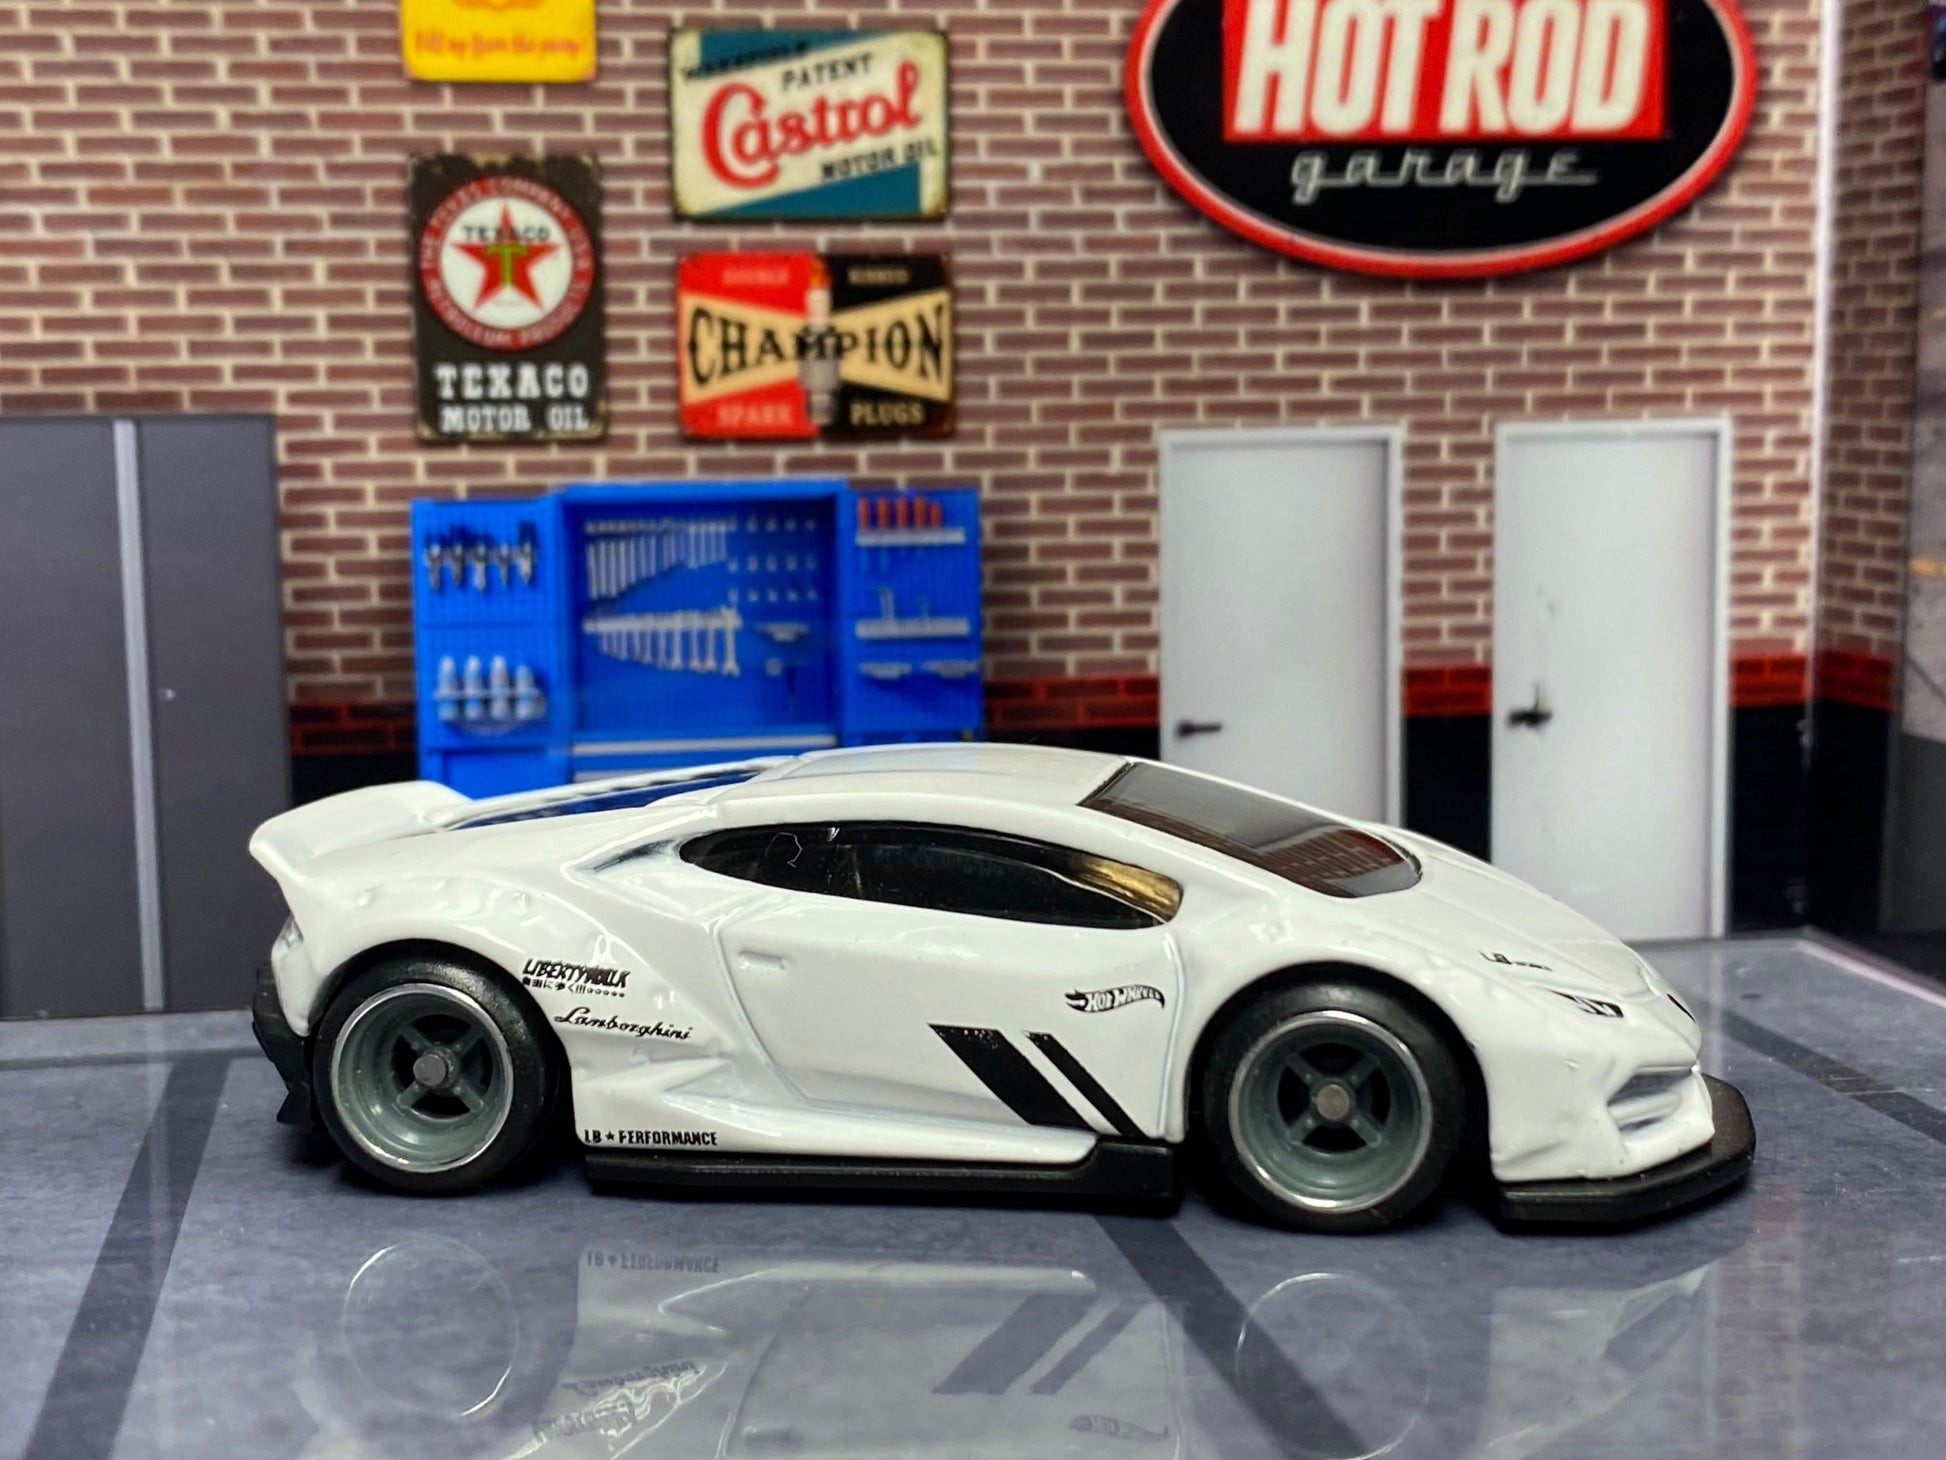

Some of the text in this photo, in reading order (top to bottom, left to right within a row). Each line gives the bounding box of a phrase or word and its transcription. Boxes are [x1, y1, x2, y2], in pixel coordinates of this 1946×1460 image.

[782, 52, 873, 89] PATENT
[1233, 0, 1653, 135] HOT ROD
[702, 59, 922, 189] Castrol
[821, 147, 897, 181] MOTOR
[1290, 148, 1598, 205] garage
[688, 303, 944, 387] CHAMPION
[434, 363, 589, 399] TEXACO
[440, 404, 589, 433] MOTOR OIL
[850, 402, 924, 426] PLUGS
[553, 1006, 693, 1040] Lamborghini
